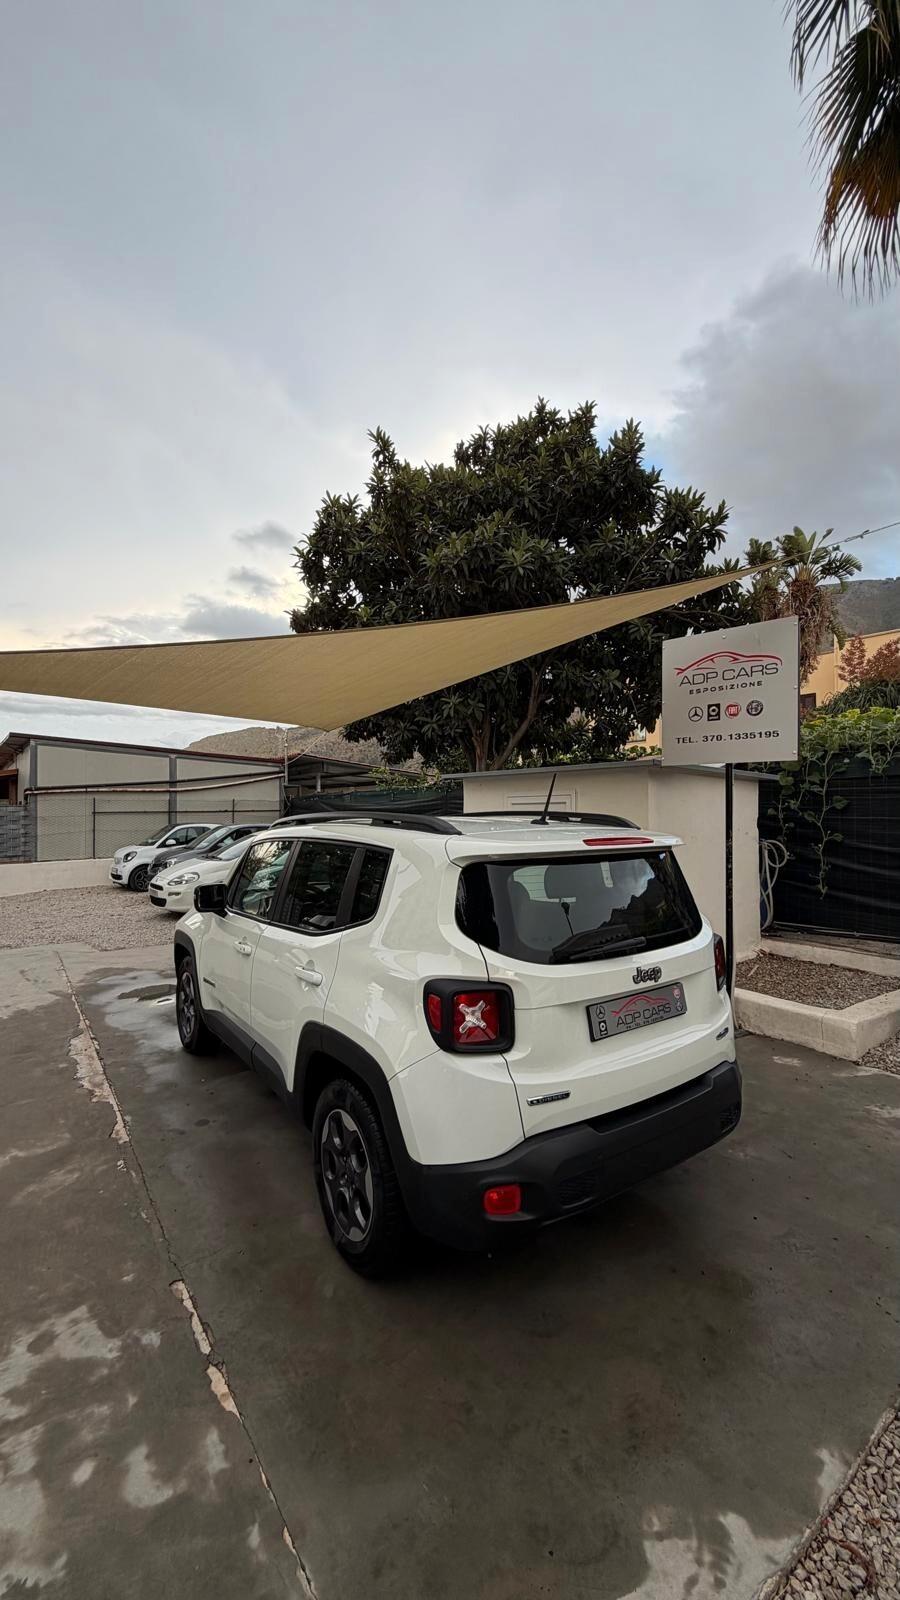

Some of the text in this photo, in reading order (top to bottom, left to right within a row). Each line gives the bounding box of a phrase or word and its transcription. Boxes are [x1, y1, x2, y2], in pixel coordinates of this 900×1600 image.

[680, 662, 779, 687] ADP CARS
[689, 680, 763, 695] ESPOSIZIONE
[676, 730, 780, 744] TEL. 370.1335195
[632, 966, 662, 984] Jeep
[642, 1002, 672, 1019] CARS
